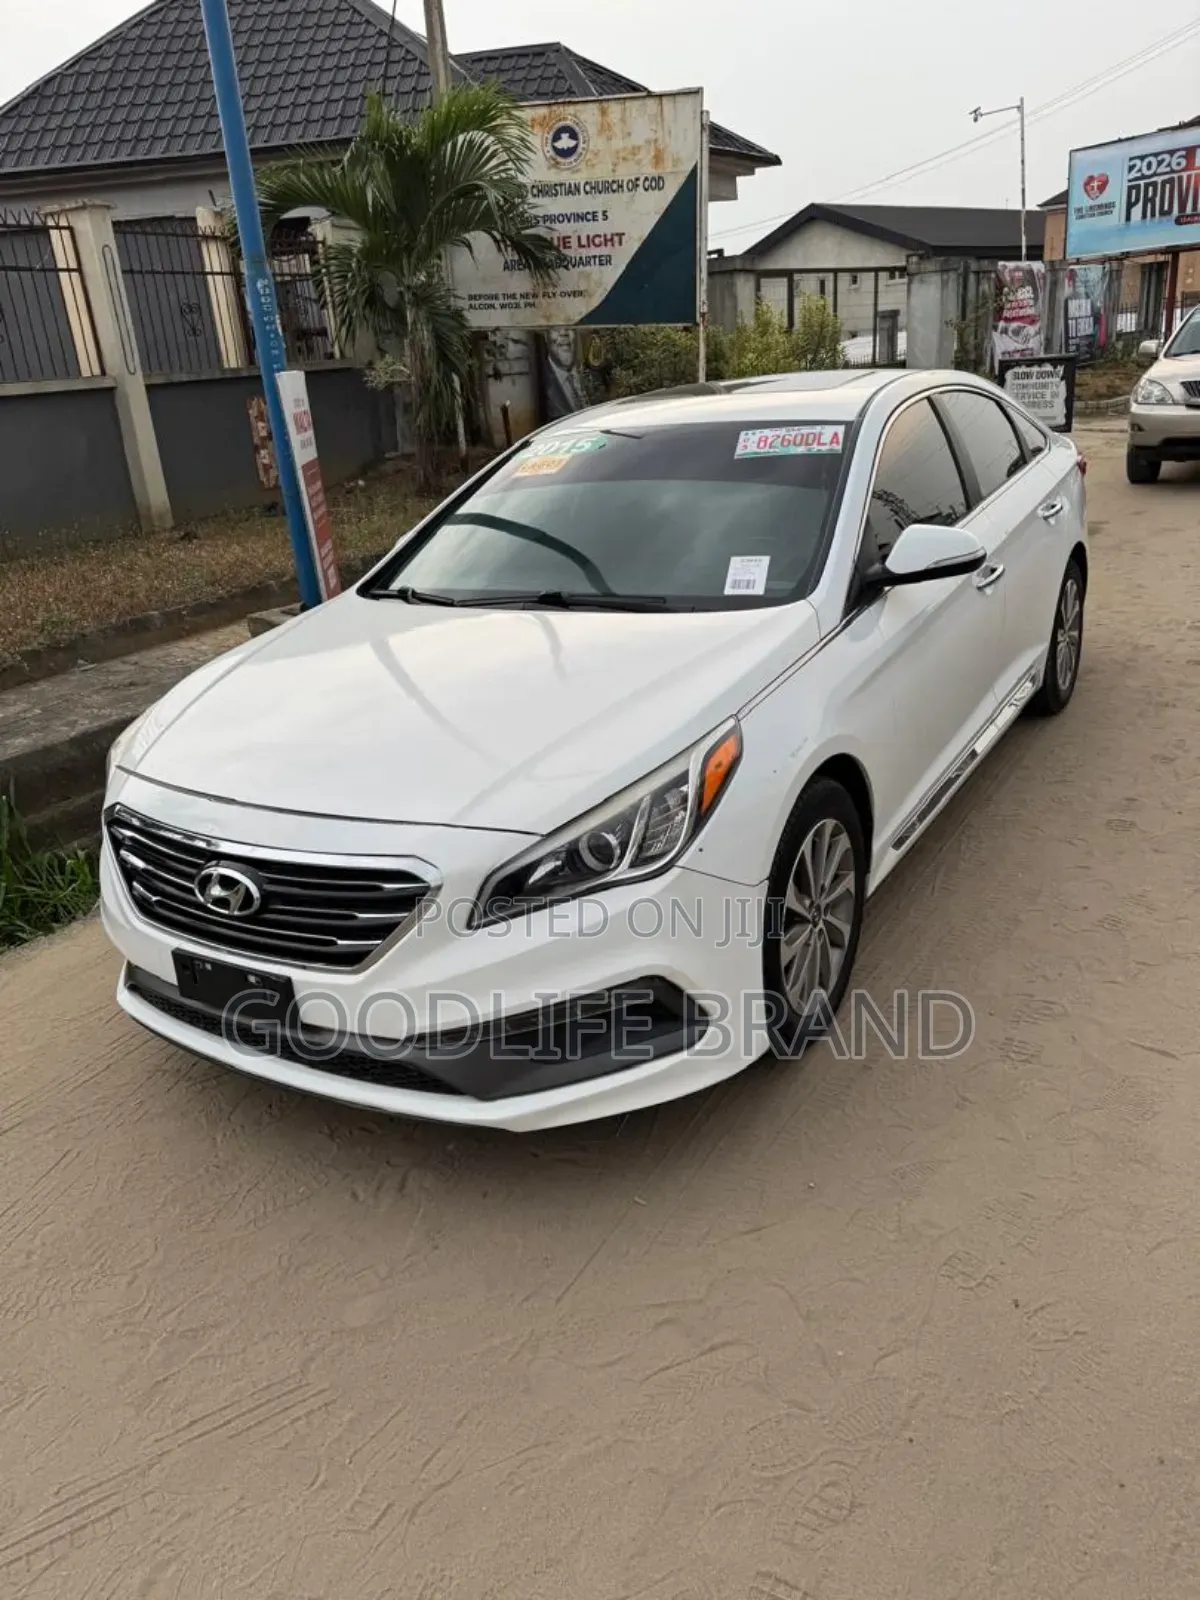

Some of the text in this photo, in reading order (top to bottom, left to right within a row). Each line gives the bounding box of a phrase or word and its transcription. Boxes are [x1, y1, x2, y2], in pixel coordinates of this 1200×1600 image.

[1128, 151, 1187, 178] 2026
[530, 181, 581, 198] CHRISTIAN
[583, 179, 623, 195] CHURCH
[626, 177, 641, 192] OF
[643, 175, 665, 192] GOD
[543, 211, 598, 225] PROVINCE
[602, 210, 609, 221] 5
[577, 232, 626, 249] LIGHT
[468, 293, 499, 302] BEFORE
[502, 292, 517, 301] THE
[520, 291, 539, 300] NEW
[541, 290, 557, 299] FLY
[1036, 369, 1061, 380] DOWN
